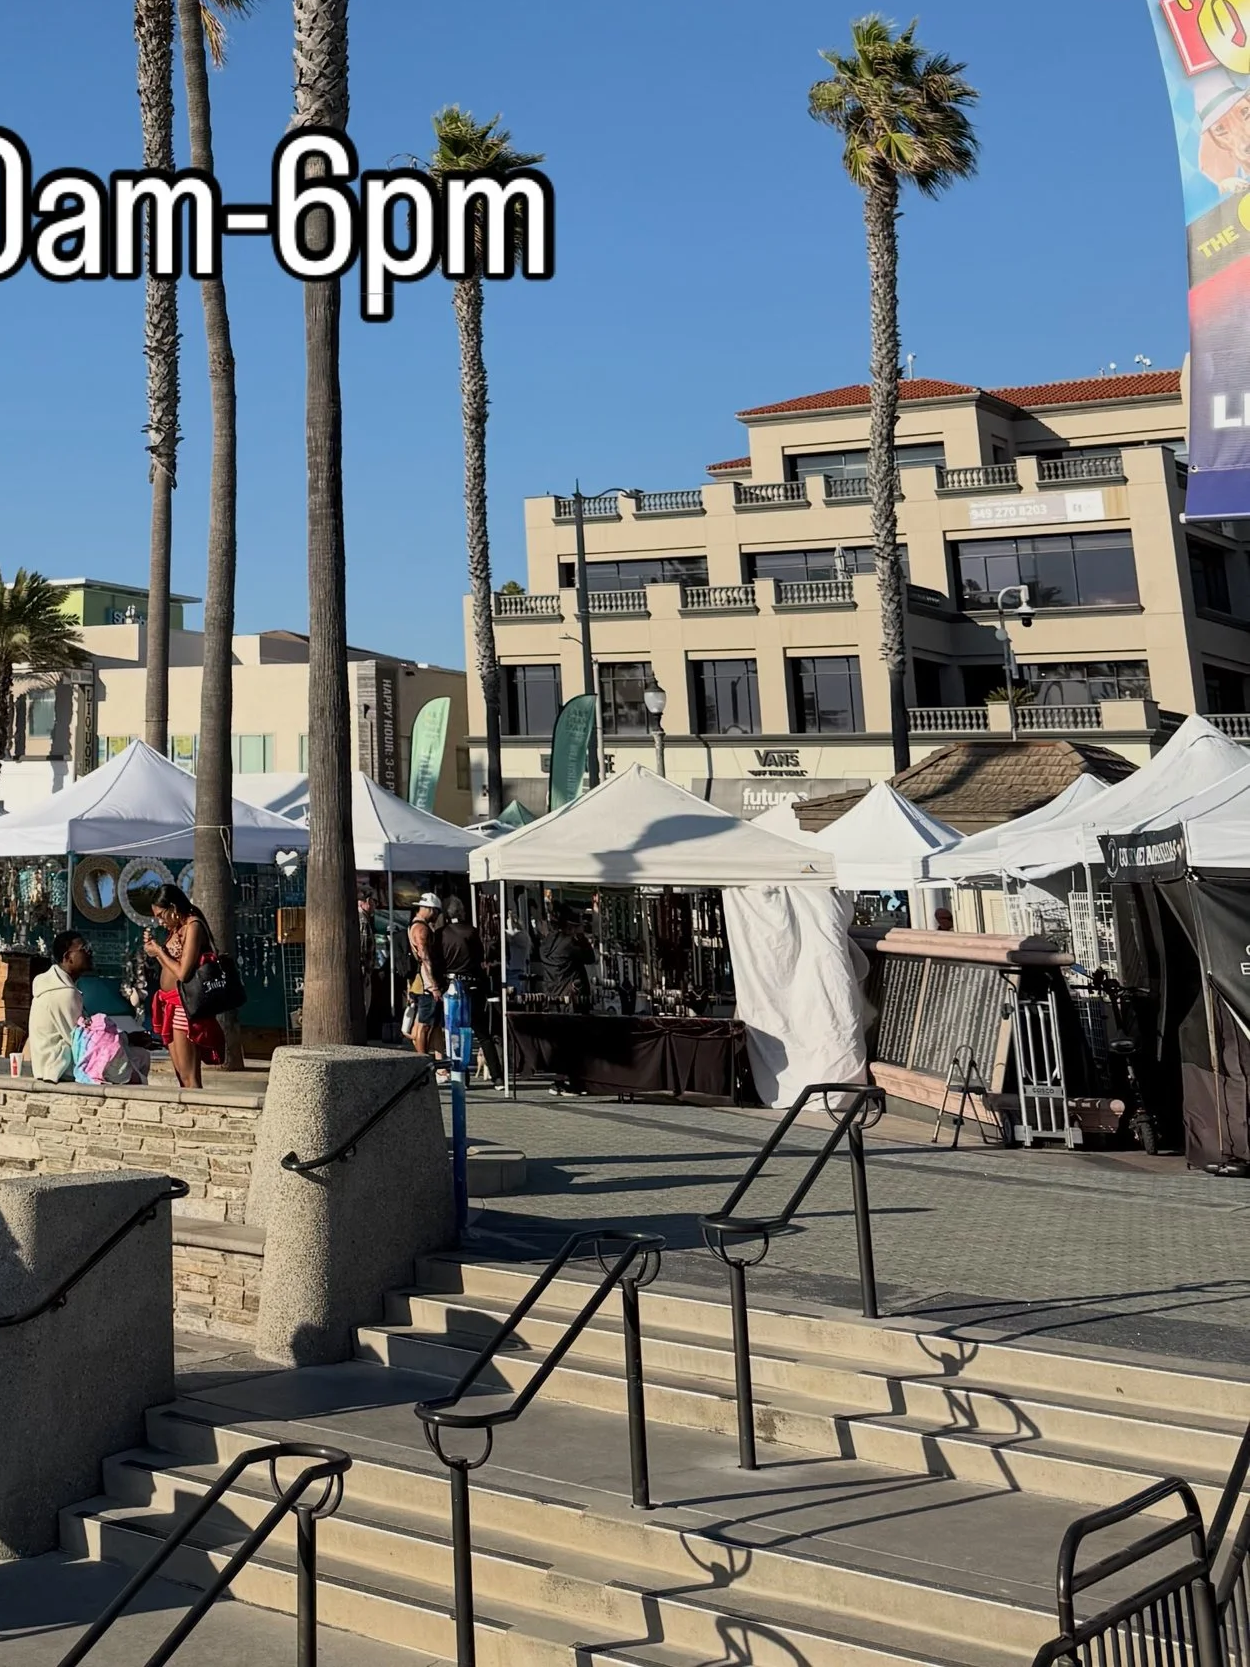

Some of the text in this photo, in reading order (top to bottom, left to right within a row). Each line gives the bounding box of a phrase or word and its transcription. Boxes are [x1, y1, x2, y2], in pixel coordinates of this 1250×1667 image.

[1197, 225, 1240, 258] THE
[382, 678, 393, 718] HAPPY
[384, 719, 395, 756] HOUR:
[754, 749, 801, 768] VANS
